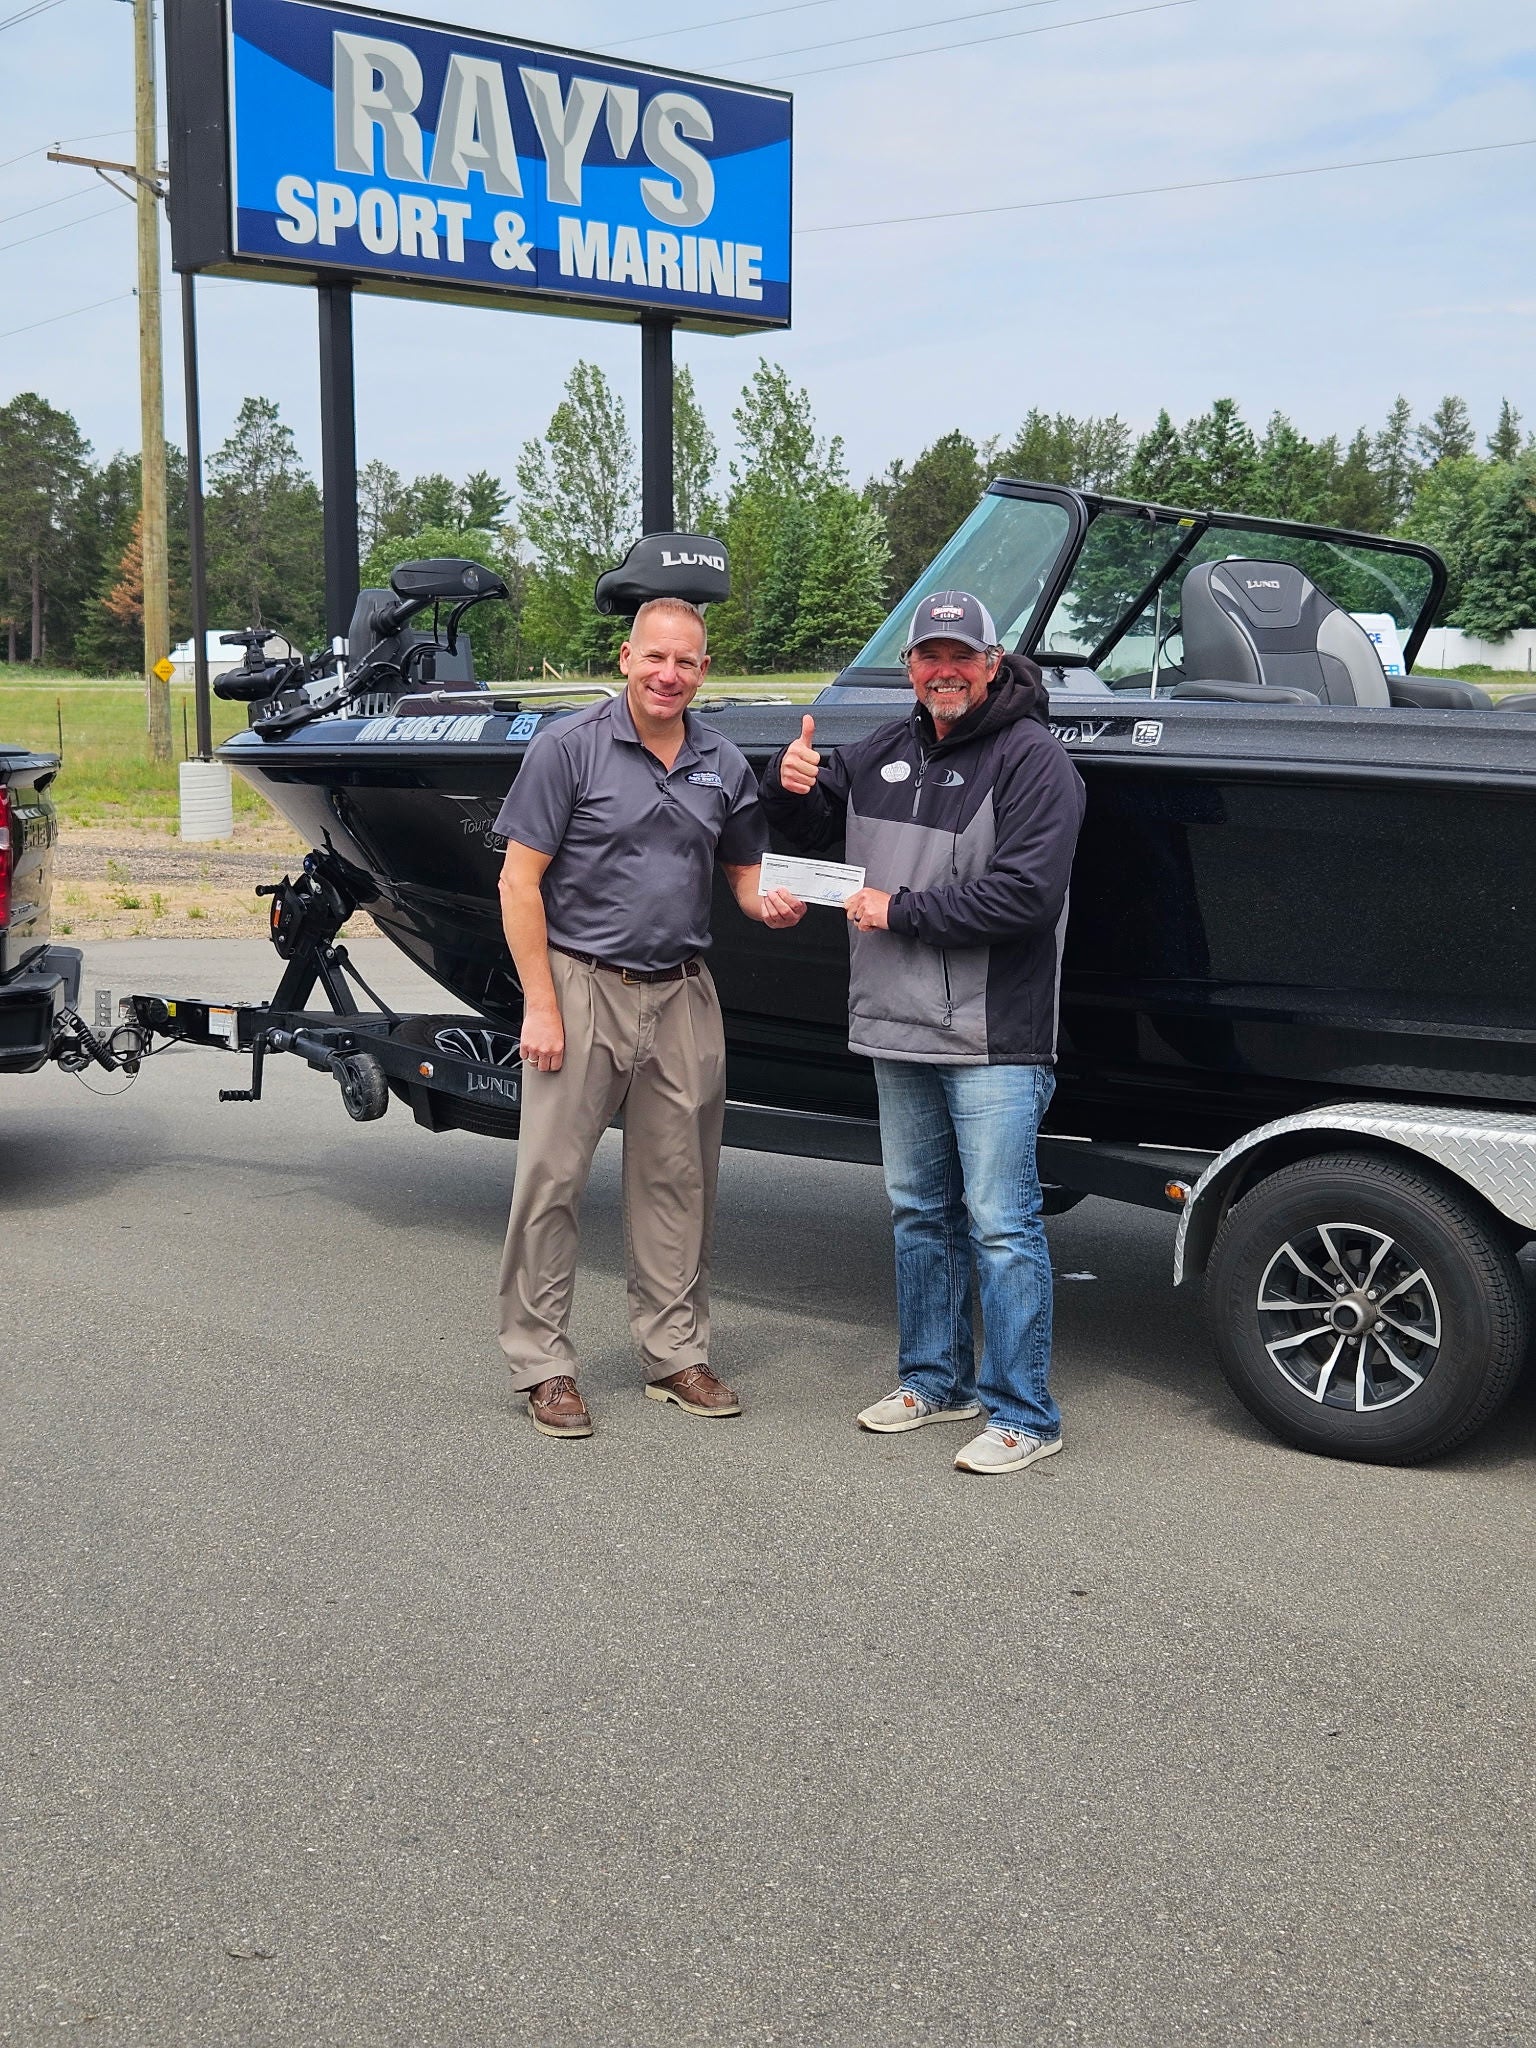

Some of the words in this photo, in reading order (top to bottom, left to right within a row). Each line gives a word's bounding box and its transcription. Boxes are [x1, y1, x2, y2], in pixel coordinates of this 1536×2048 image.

[333, 31, 716, 227] RAY'S
[276, 175, 472, 263] SPORT
[490, 211, 537, 272] &
[558, 216, 763, 301] MARINE
[661, 551, 726, 572] LUND
[1245, 580, 1280, 589] LUND
[510, 719, 534, 735] 25
[1137, 725, 1158, 736] 75
[467, 1072, 517, 1101] LUND
